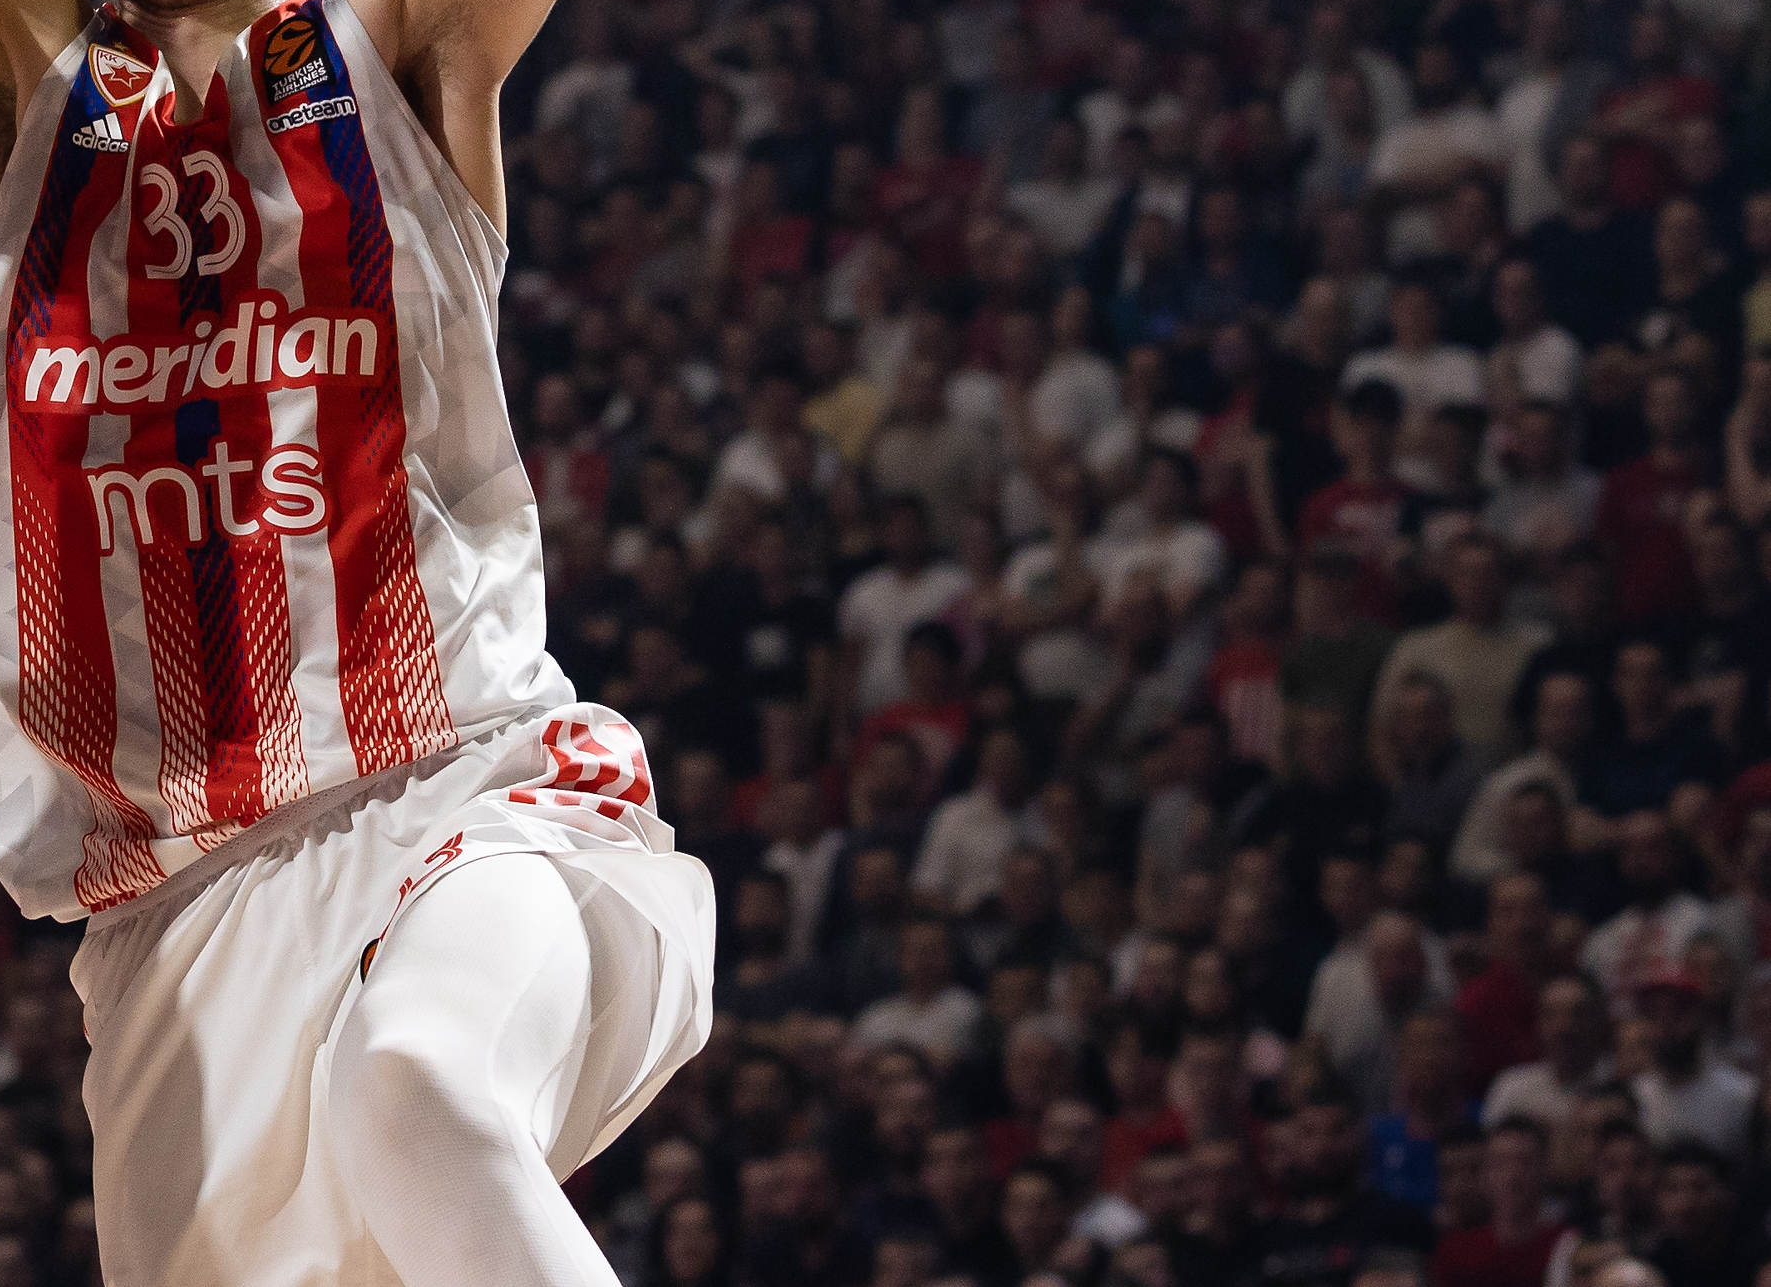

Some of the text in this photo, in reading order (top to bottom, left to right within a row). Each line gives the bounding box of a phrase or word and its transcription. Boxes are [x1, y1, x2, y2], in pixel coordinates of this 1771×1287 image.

[272, 57, 325, 91] TURKISH
[273, 66, 327, 96] AIRLINES
[72, 129, 129, 153] adidas
[139, 149, 246, 280] 33
[24, 300, 379, 404] meridian
[87, 441, 327, 551] mts
